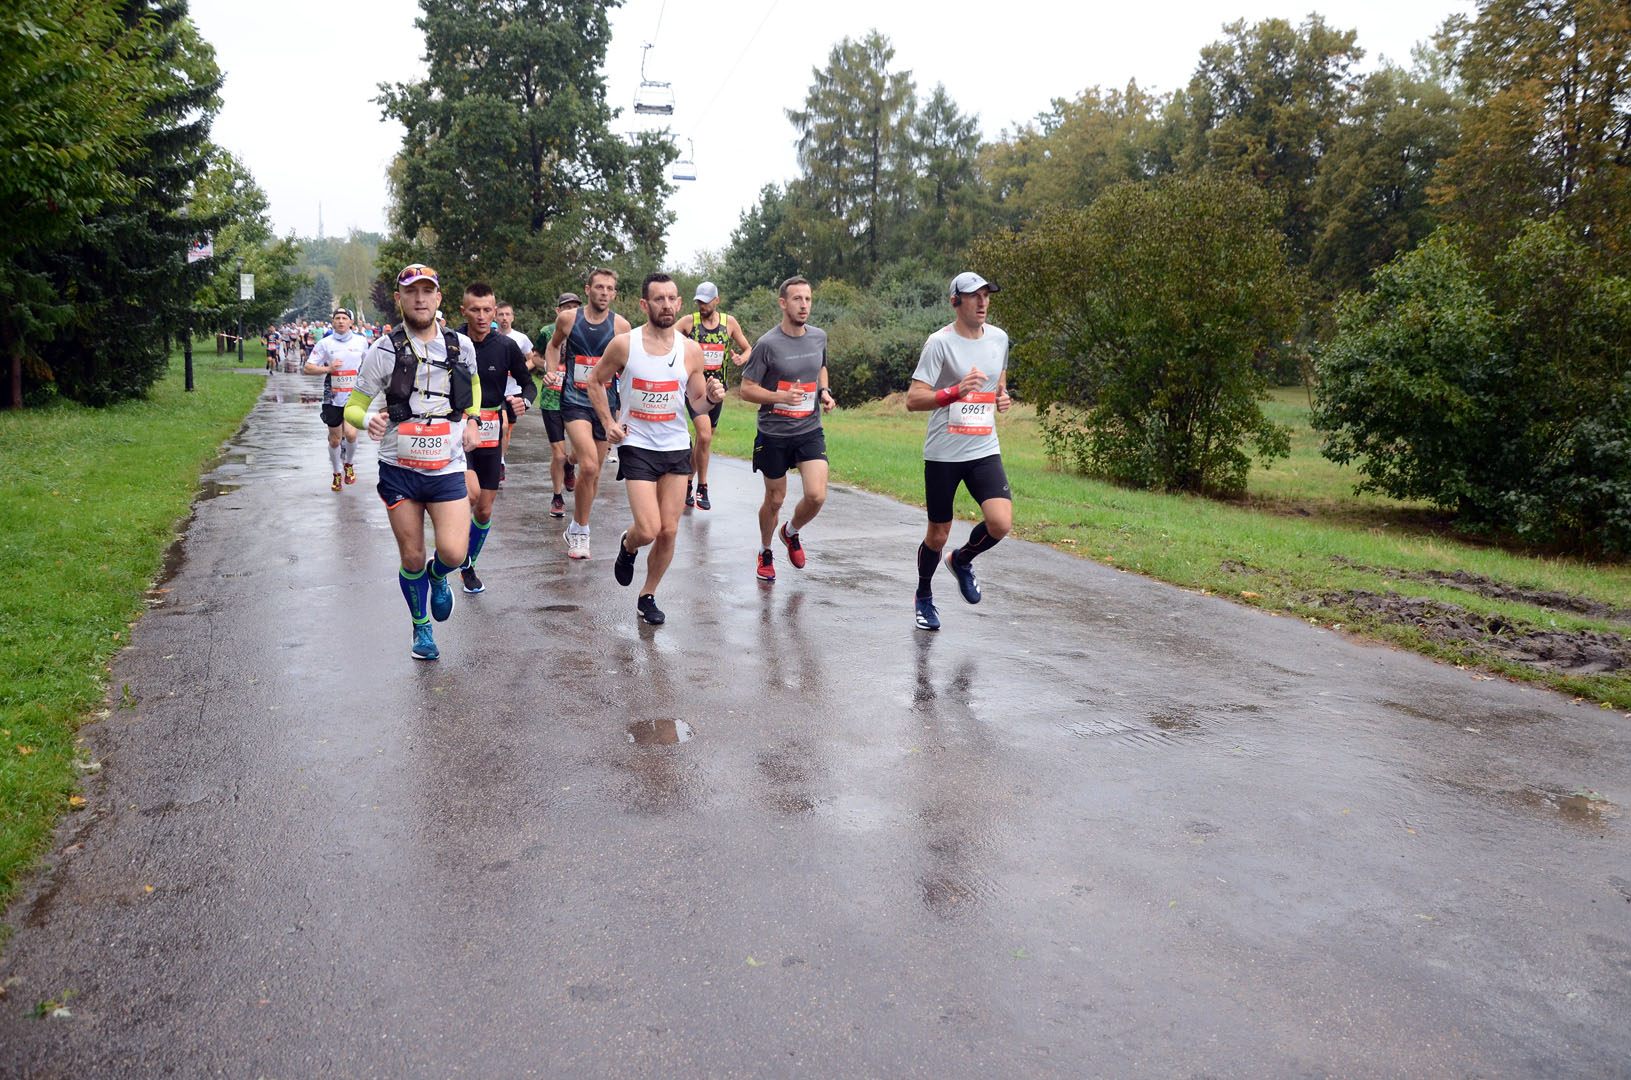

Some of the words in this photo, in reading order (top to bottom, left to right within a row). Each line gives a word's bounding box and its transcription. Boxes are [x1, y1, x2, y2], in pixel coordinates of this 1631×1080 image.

[641, 391, 669, 403] 7224
[961, 404, 985, 415] 6961
[410, 436, 442, 449] 7838
